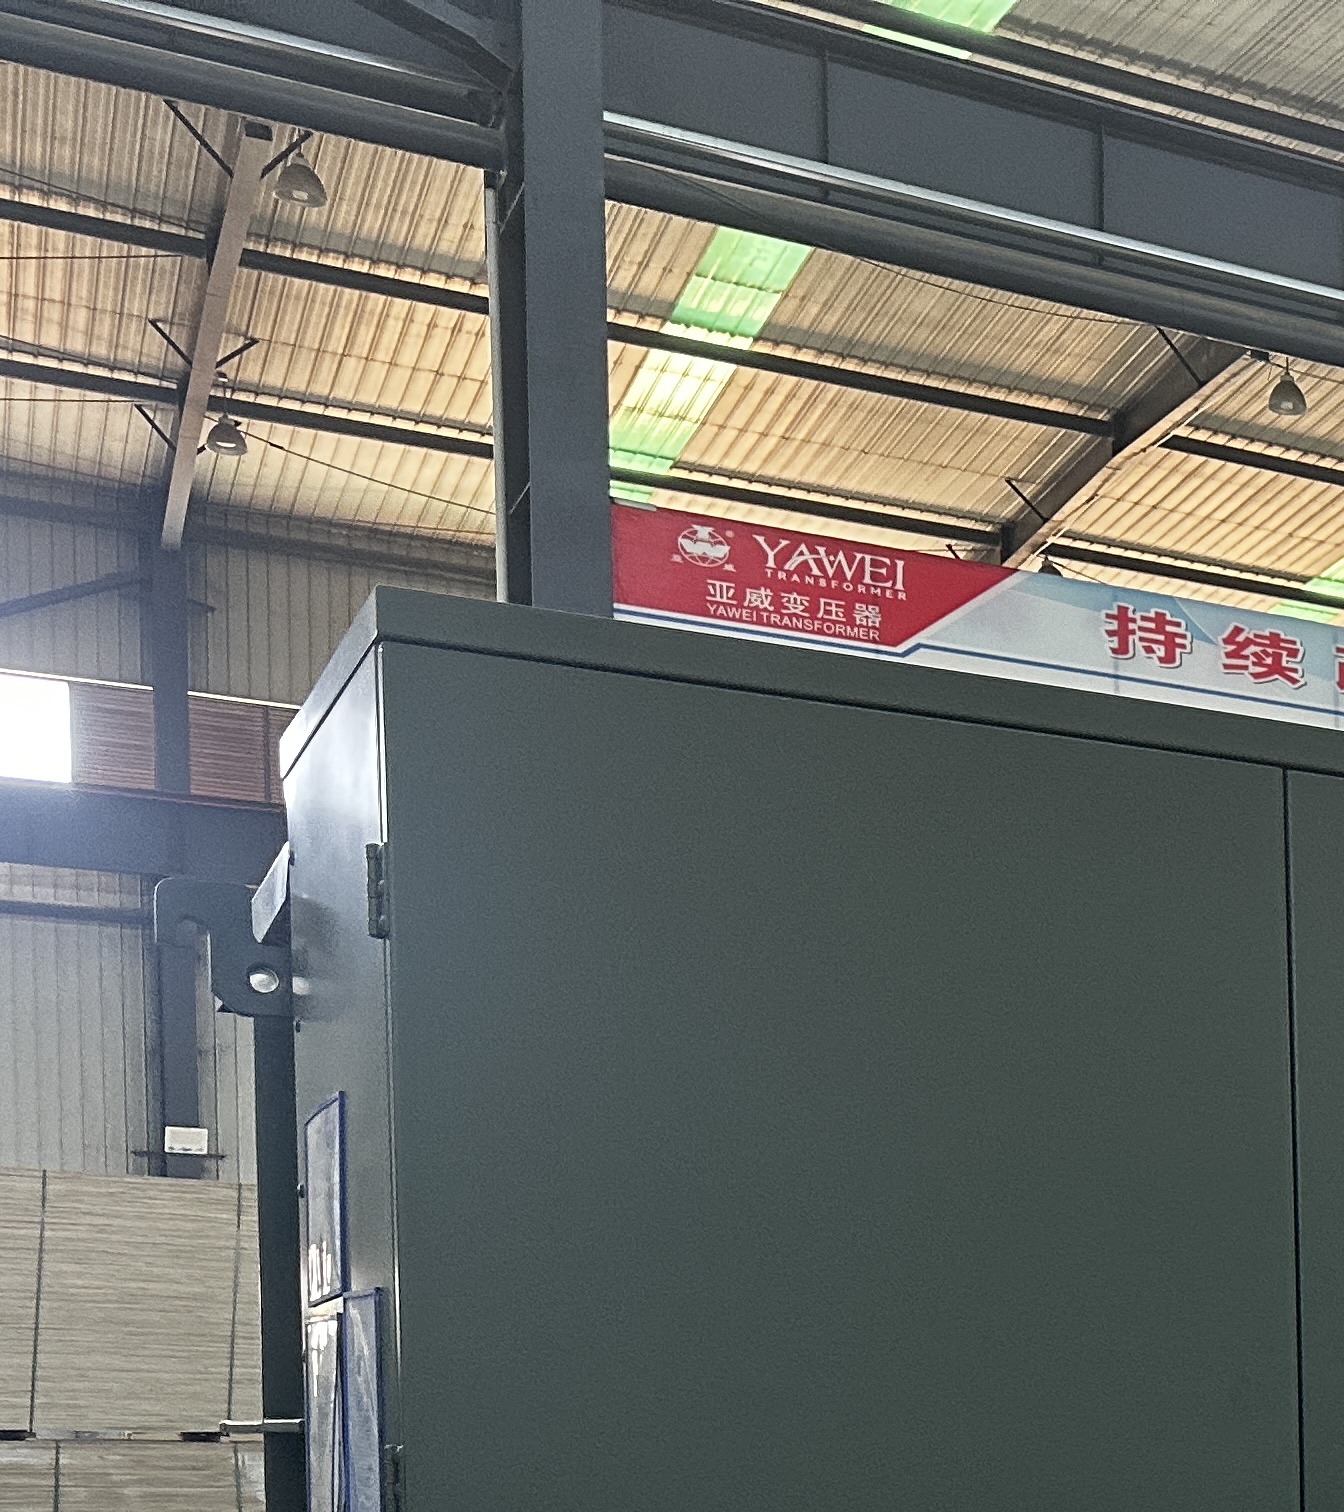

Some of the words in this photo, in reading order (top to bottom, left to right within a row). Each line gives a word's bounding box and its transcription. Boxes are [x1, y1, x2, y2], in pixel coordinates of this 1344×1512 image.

[752, 534, 906, 591] YAWEI
[765, 568, 907, 600] TRANSFORMER
[706, 579, 882, 628] 亚威变压器
[706, 603, 758, 624] YAWEI
[759, 612, 882, 641] TRANSFORMER
